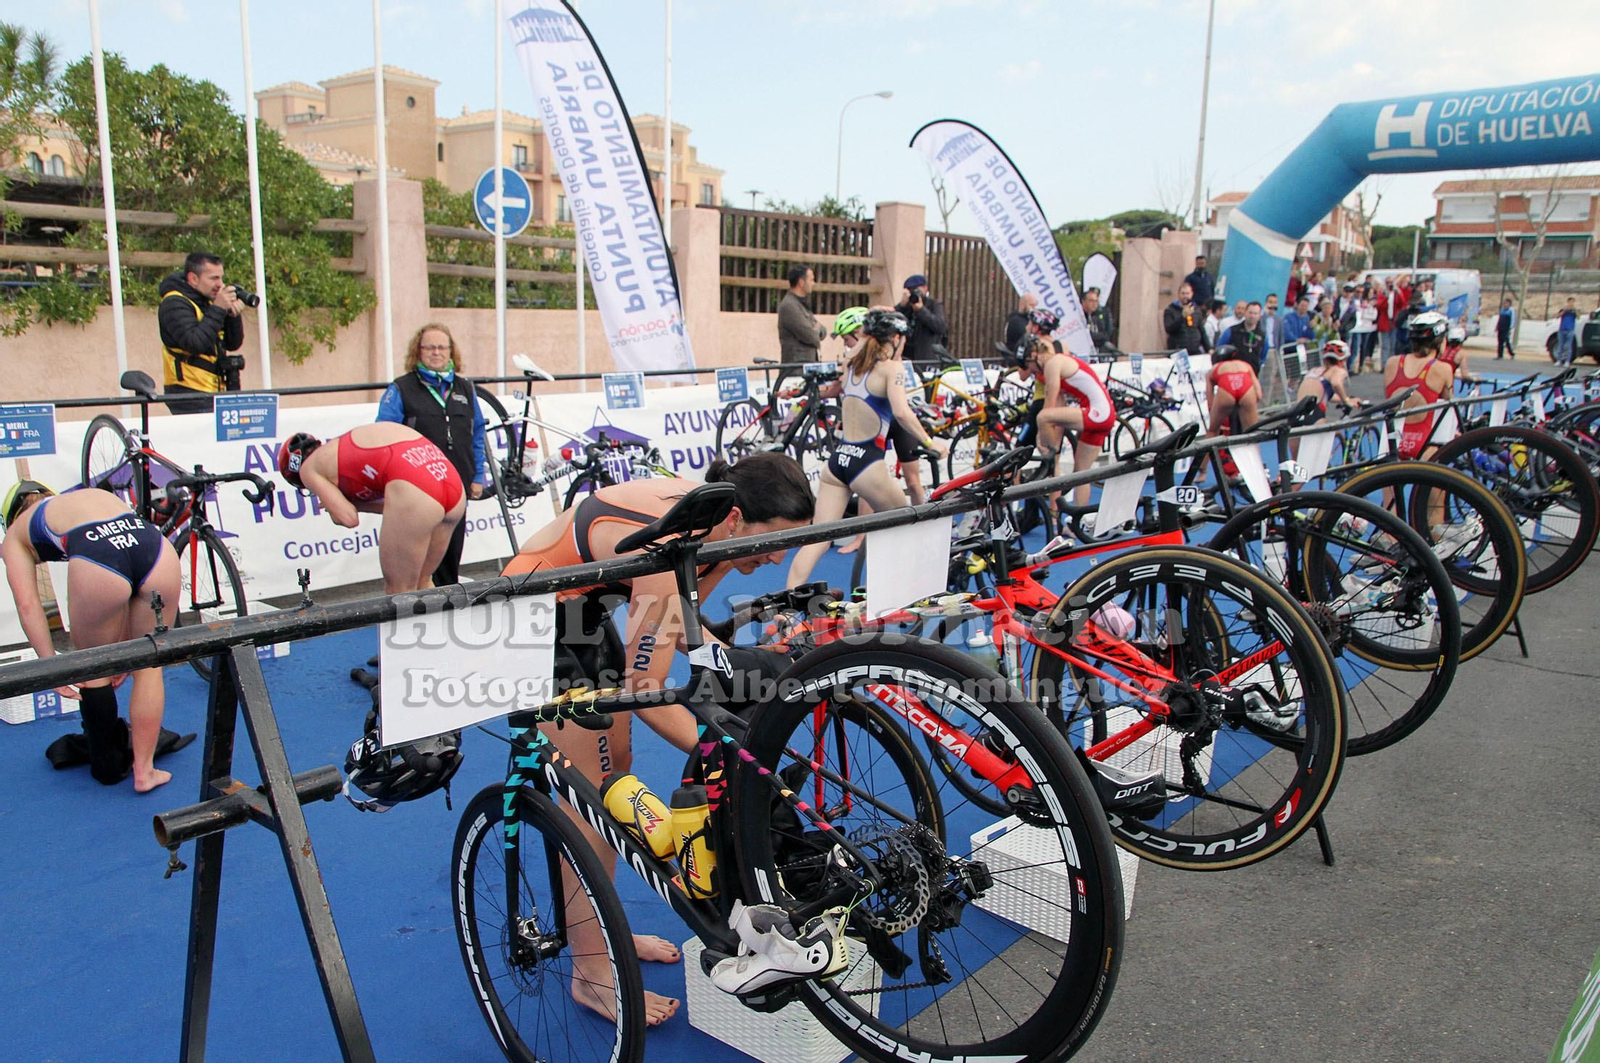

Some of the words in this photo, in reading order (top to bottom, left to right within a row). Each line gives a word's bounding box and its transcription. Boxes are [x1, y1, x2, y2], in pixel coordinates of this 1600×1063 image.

[1437, 122, 1470, 147] DE
[1478, 110, 1592, 144] HUELVA
[6, 421, 29, 430] MERLE
[222, 410, 239, 425] 23
[23, 430, 40, 438] FRA
[289, 454, 300, 471] 23
[426, 461, 448, 482] ESP
[1177, 489, 1197, 503] 20
[85, 518, 146, 542] C.MERLE
[108, 532, 139, 550] FRA
[633, 635, 657, 672] 22
[37, 693, 56, 709] 25
[1114, 781, 1154, 800] DMT
